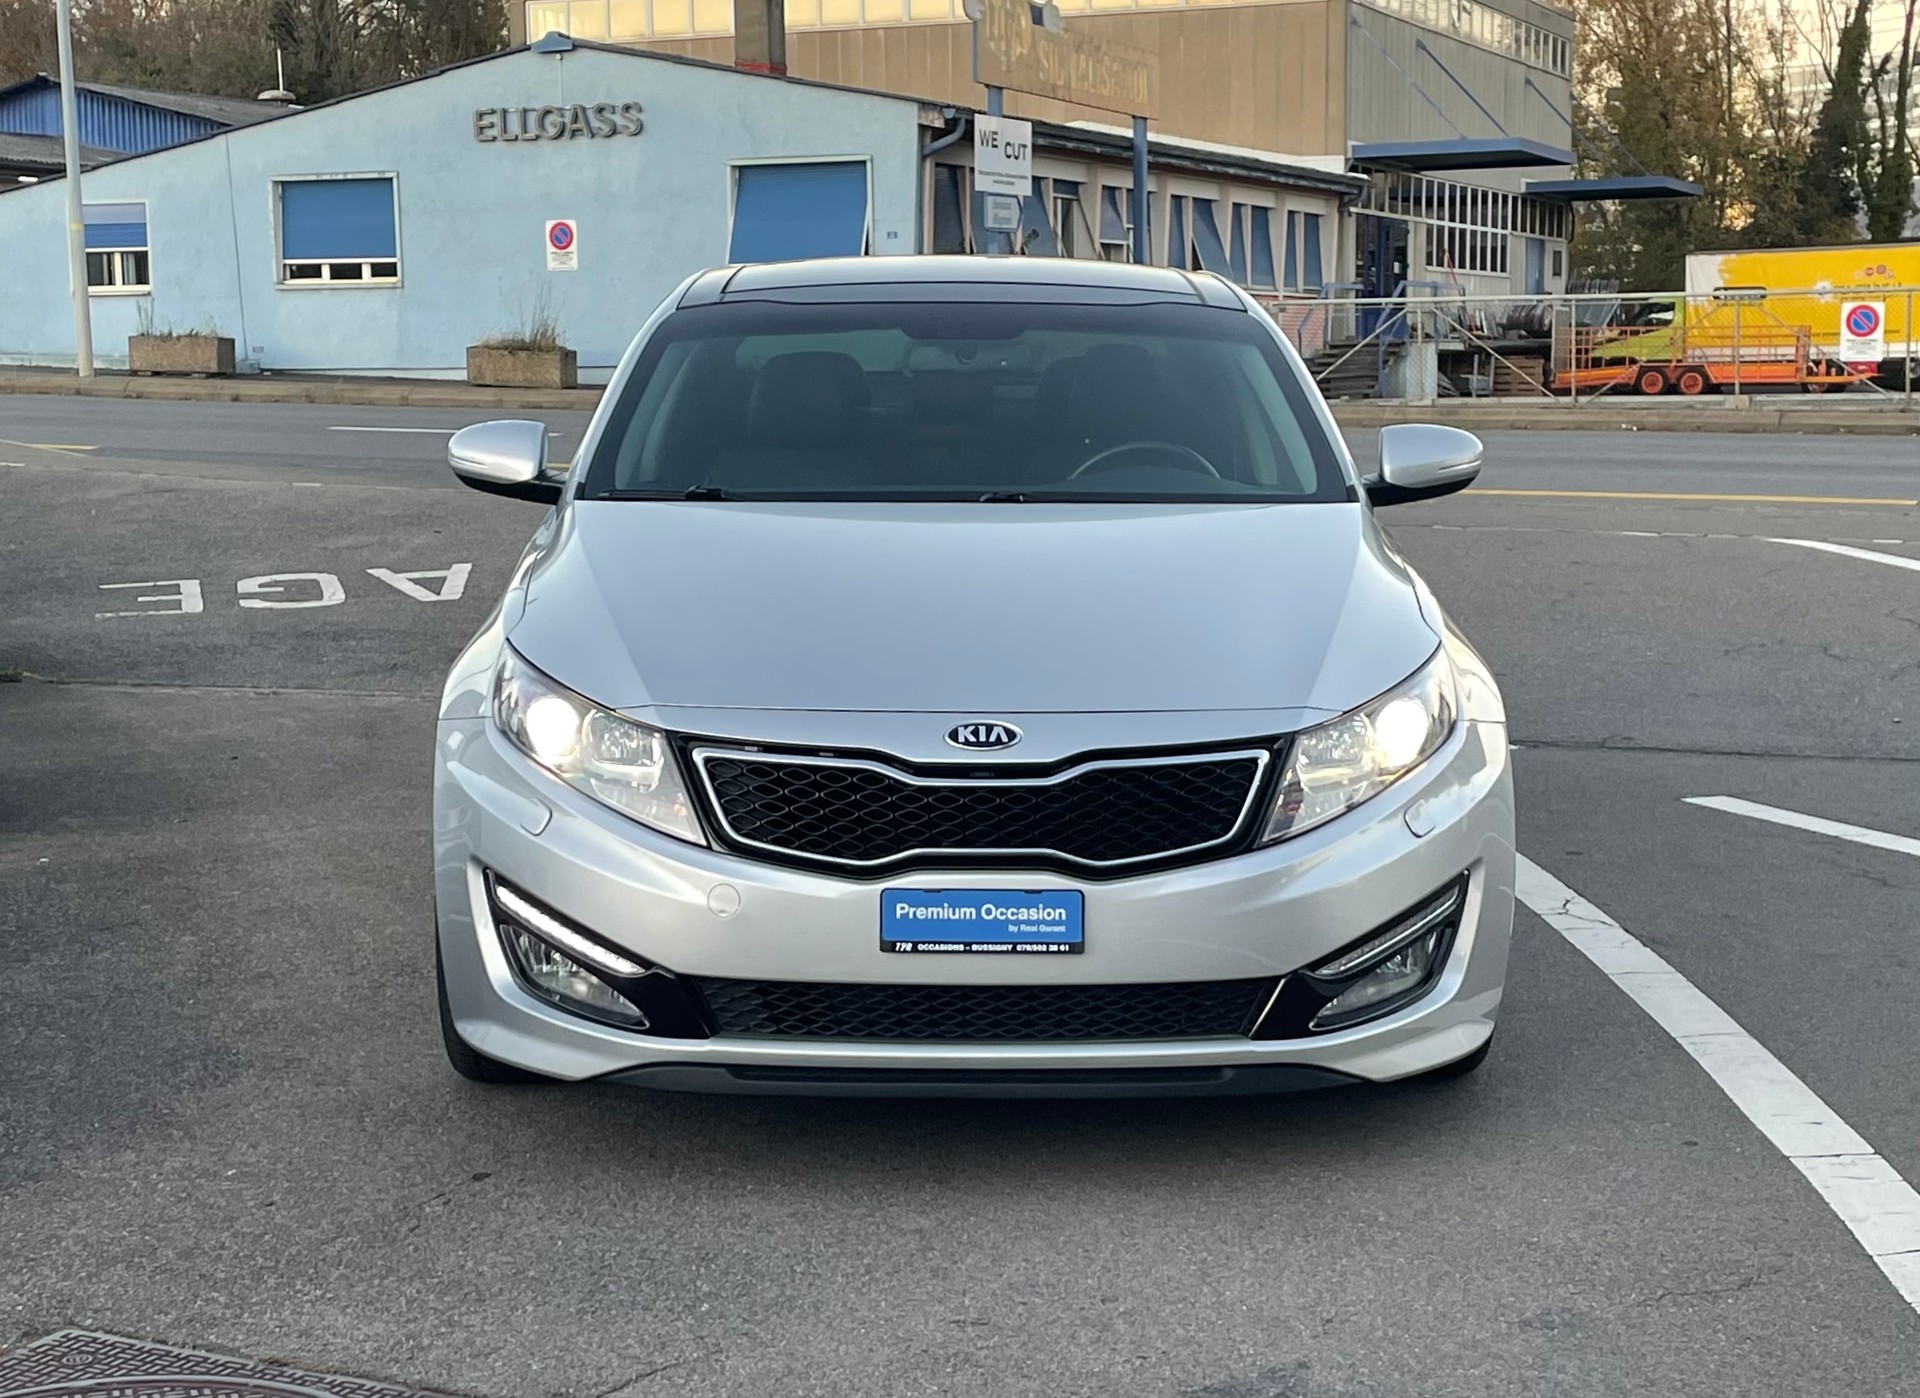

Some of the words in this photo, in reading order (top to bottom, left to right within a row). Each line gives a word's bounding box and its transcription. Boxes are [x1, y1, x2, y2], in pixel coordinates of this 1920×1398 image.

[473, 101, 646, 143] ELLGASS
[979, 129, 999, 148] WE
[1004, 141, 1028, 161] CUT
[957, 725, 1009, 743] KIA
[895, 903, 976, 920] Premium
[981, 903, 1066, 921] Occasion
[1008, 924, 1019, 933] by
[917, 943, 964, 951] OCCASIONS
